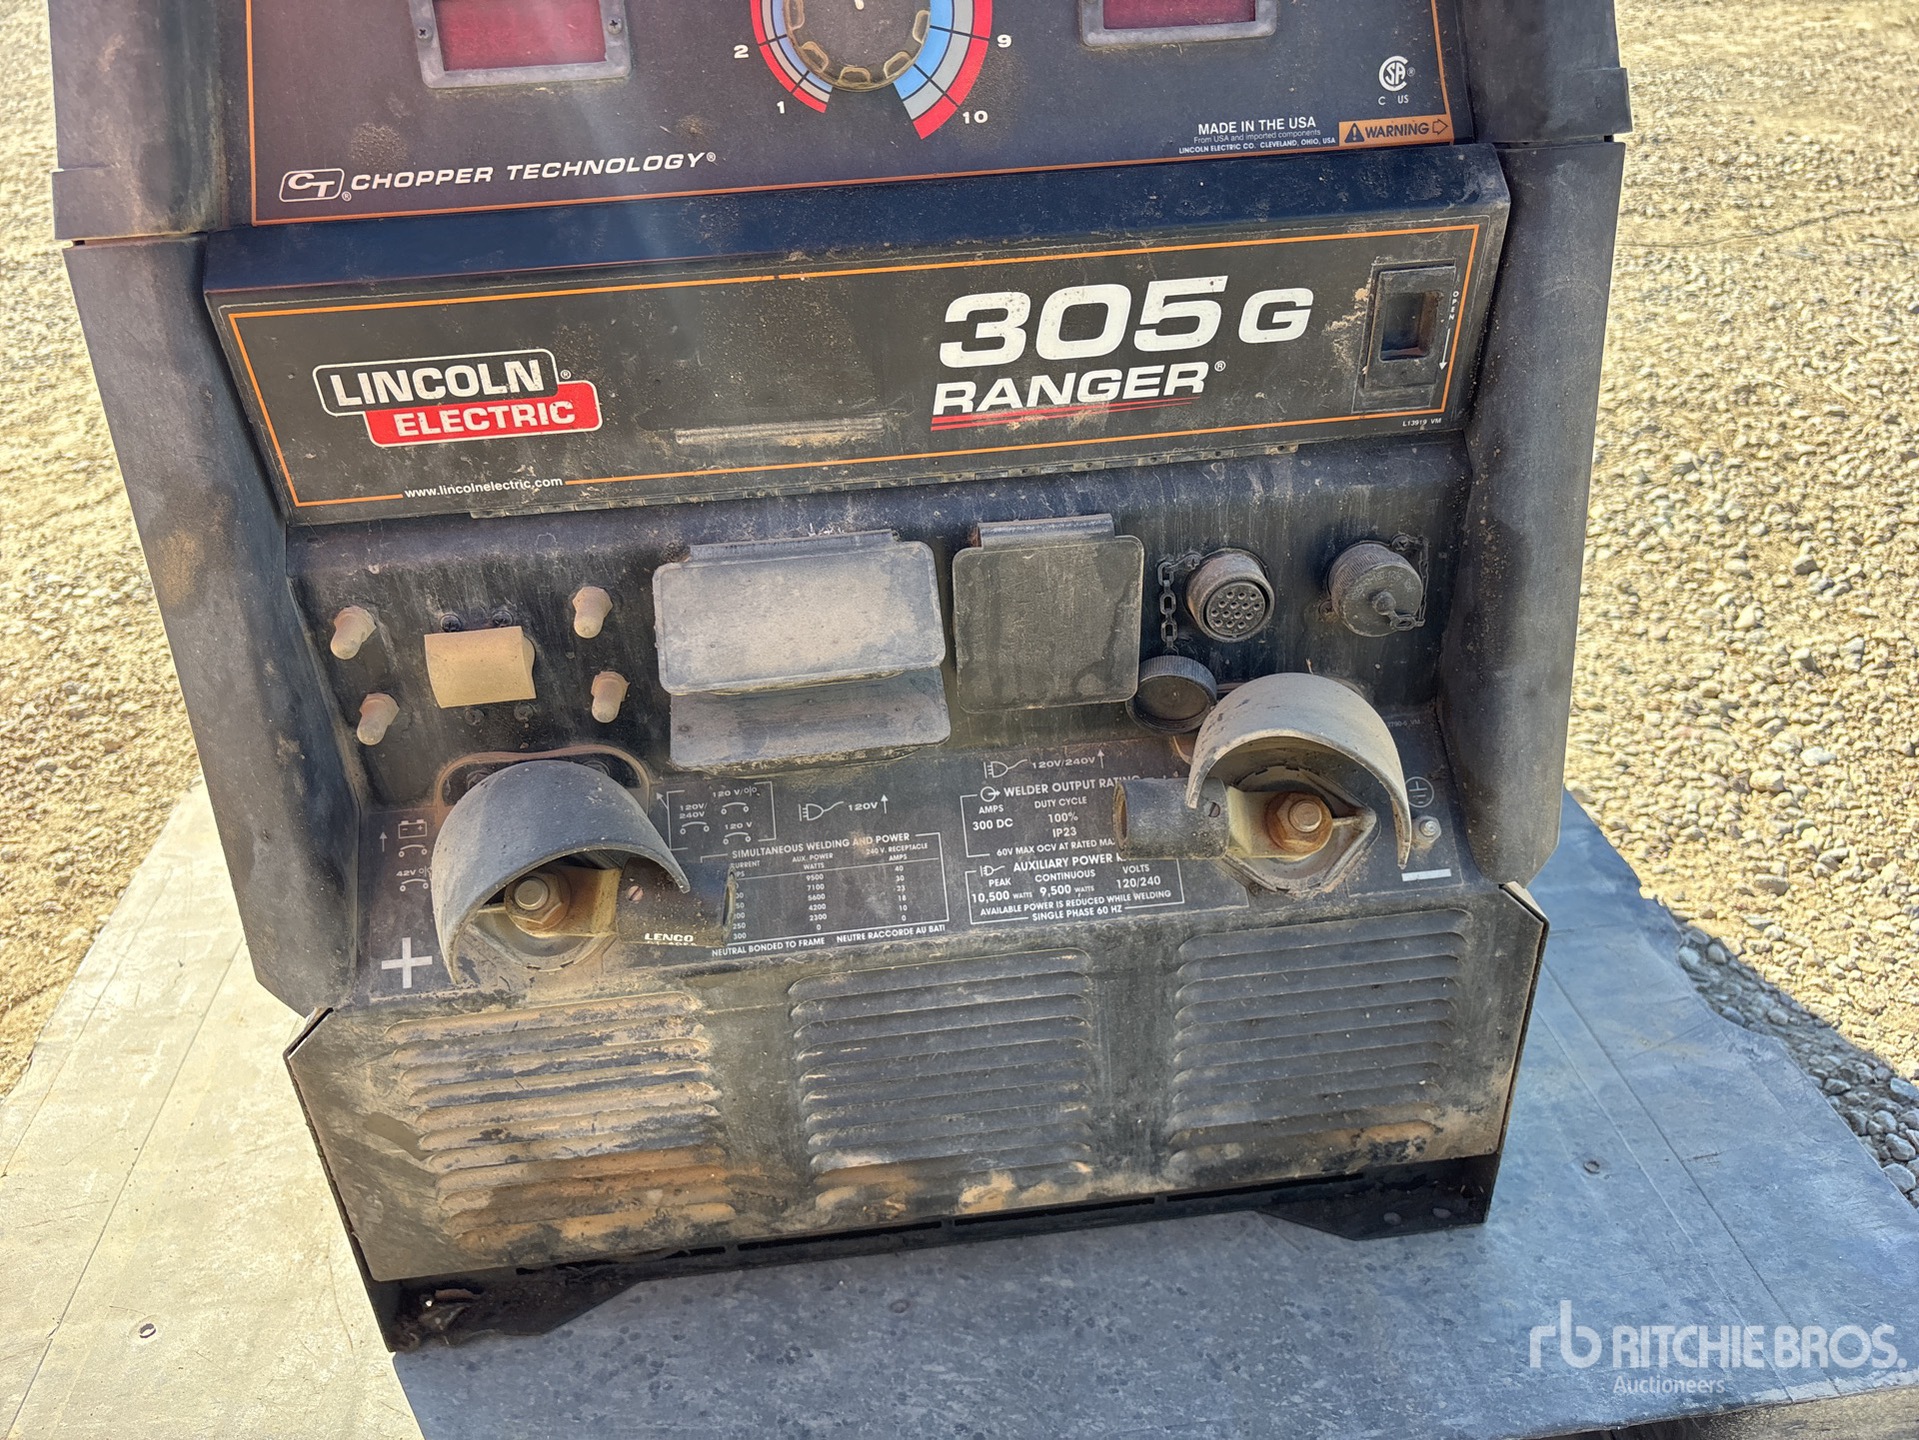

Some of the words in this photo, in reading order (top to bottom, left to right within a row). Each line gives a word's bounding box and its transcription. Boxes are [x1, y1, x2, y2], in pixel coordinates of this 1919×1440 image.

[997, 34, 1012, 48] 9
[734, 45, 749, 58] 2
[1397, 94, 1409, 104] US
[777, 101, 785, 114] 1
[963, 110, 988, 124] 10
[1198, 121, 1237, 135] MADE
[1241, 119, 1254, 133] IN
[1258, 118, 1285, 131] THE
[1289, 116, 1316, 129] USA
[1365, 122, 1429, 138] WARNING
[1193, 136, 1212, 144] From
[1214, 135, 1229, 143] USA
[1230, 133, 1244, 141] and
[1246, 130, 1277, 142] imported
[1278, 128, 1321, 139] components
[1179, 145, 1208, 154] LINCOLN
[1210, 143, 1241, 152] ELECTRIC
[1243, 142, 1256, 150] CO.
[1260, 139, 1299, 149] CLEVELAND,
[1301, 138, 1321, 146] OHIO,
[351, 166, 493, 190] CHOPPER
[507, 152, 705, 180] TECHNOLOGY
[1448, 290, 1460, 320] OPEN
[940, 275, 1228, 368] 305
[1238, 287, 1313, 344] G
[330, 359, 545, 407] LINCOLN
[932, 361, 1209, 415] RANGER
[393, 400, 576, 437] ELECTRIC
[405, 476, 563, 498] www.lincolnelectric.com
[1032, 756, 1096, 769] 120V/240V
[713, 789, 731, 798] 120
[1003, 783, 1049, 797] WELDER
[1051, 780, 1096, 794] OUTPUT
[680, 802, 708, 811] 120V/
[848, 801, 878, 811] 120V
[979, 804, 1004, 814] AMPS
[1034, 799, 1056, 809] DUTY
[1058, 796, 1087, 807] CYCLE
[679, 811, 705, 819] 240V
[1048, 811, 1078, 824] 100%
[725, 822, 743, 830] 120
[972, 818, 993, 831] 300
[996, 817, 1013, 829] DC
[1052, 826, 1077, 838] IP23
[732, 843, 803, 859] SIMULTANEOUS
[806, 838, 850, 851] WELDING
[852, 836, 873, 846] AND
[876, 832, 909, 844] POWER
[888, 842, 928, 853] RECEPTACLE
[996, 847, 1016, 857] 60V
[1016, 845, 1035, 855] MAX
[1037, 843, 1057, 852] OCV
[1059, 841, 1069, 850] AT
[1070, 839, 1097, 849] RATED
[792, 855, 808, 863] AUX.
[809, 852, 833, 860] POWER
[889, 853, 907, 861] AMPS
[1013, 858, 1069, 873] AUXILIARY
[1072, 853, 1113, 867] POWER
[803, 862, 825, 870] WATTS
[1122, 863, 1150, 874] VOLTS
[395, 869, 417, 877] 42V
[806, 873, 824, 881] 9500
[1035, 869, 1096, 883] CONTINUOUS
[807, 883, 825, 891] 7100
[988, 877, 1012, 887] PEAK
[1116, 875, 1161, 889] 120/240
[807, 893, 826, 901] 5600
[1039, 884, 1072, 897] 9,500
[1074, 885, 1094, 893] WATTS
[972, 890, 1010, 905] 10,500
[1013, 891, 1033, 899] WATTS
[980, 905, 1022, 916] AVAILABLE
[1023, 901, 1054, 912] POWER
[1055, 900, 1064, 909] IS
[1065, 896, 1105, 908] REDUCED
[1106, 893, 1132, 905] WHILE
[1133, 889, 1171, 902] WELDING
[808, 903, 827, 911] 4200
[809, 913, 827, 921] 2300
[899, 904, 908, 912] 10
[1032, 910, 1065, 921] SINGLE
[1067, 907, 1094, 918] PHASE
[1096, 905, 1108, 915] 60
[1111, 904, 1122, 914] HZ
[732, 922, 746, 930] 250
[644, 933, 694, 942] LENCO
[711, 945, 747, 958] NEUTRAL
[748, 940, 783, 953] BONDED
[785, 939, 796, 948] TO
[798, 936, 825, 947] FRAME
[836, 931, 865, 943] NEUTRE
[868, 926, 914, 938] RACCORDE
[915, 925, 926, 933] AU
[928, 924, 945, 933] BATI
[733, 932, 747, 940] 300
